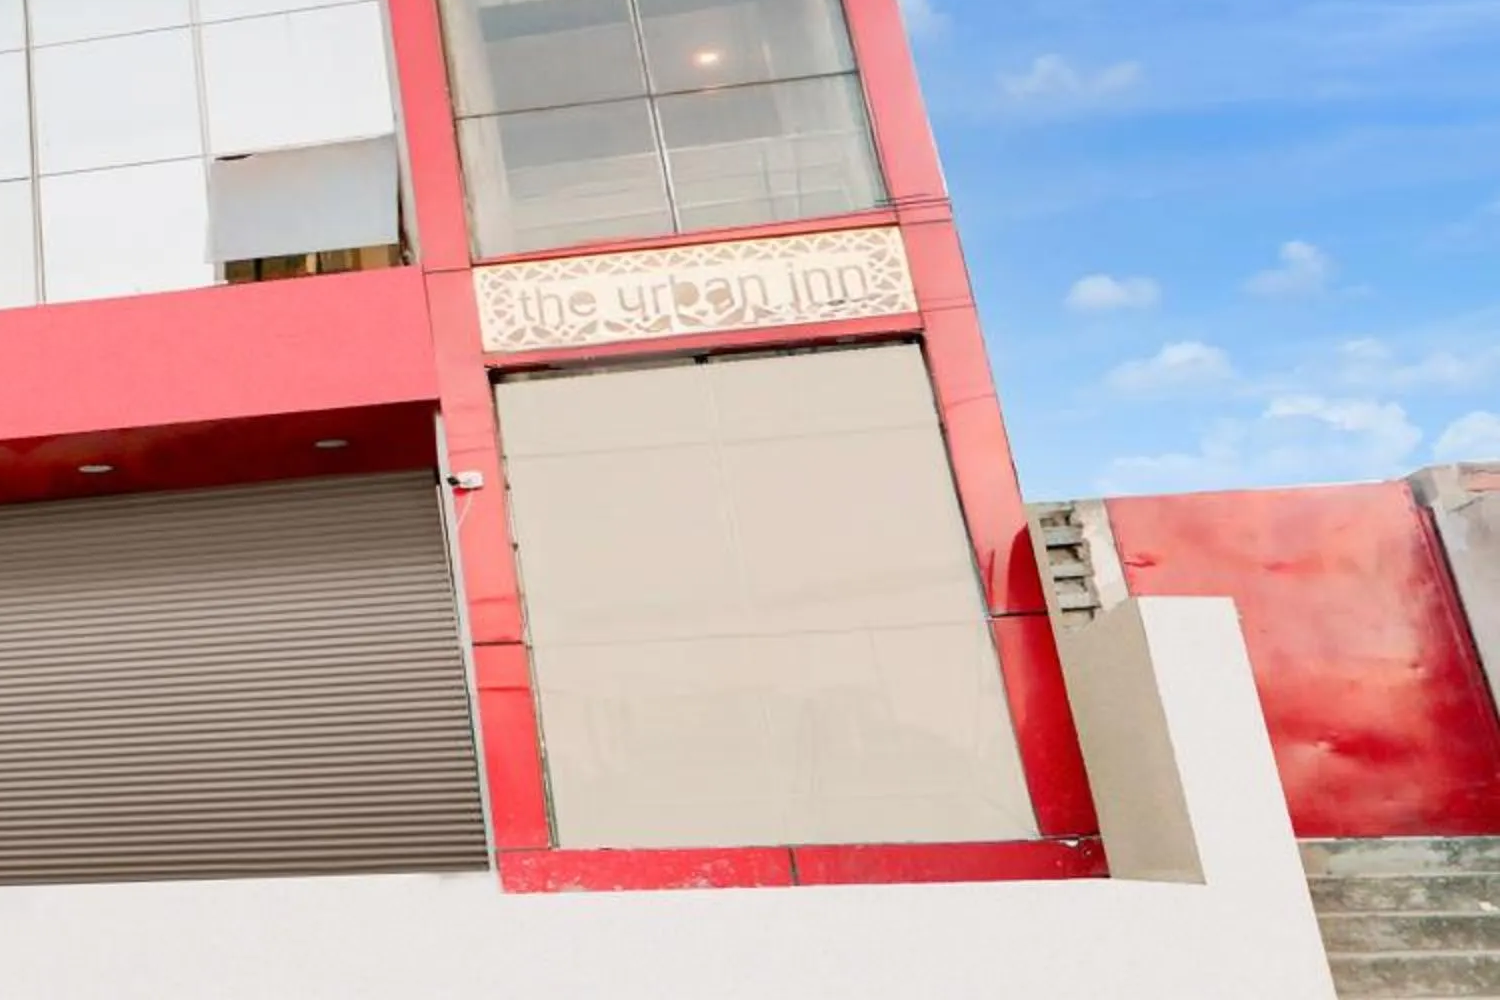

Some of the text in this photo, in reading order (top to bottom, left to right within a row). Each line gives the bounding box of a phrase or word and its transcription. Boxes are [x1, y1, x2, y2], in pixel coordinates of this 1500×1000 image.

[518, 262, 870, 327] the urban inn
